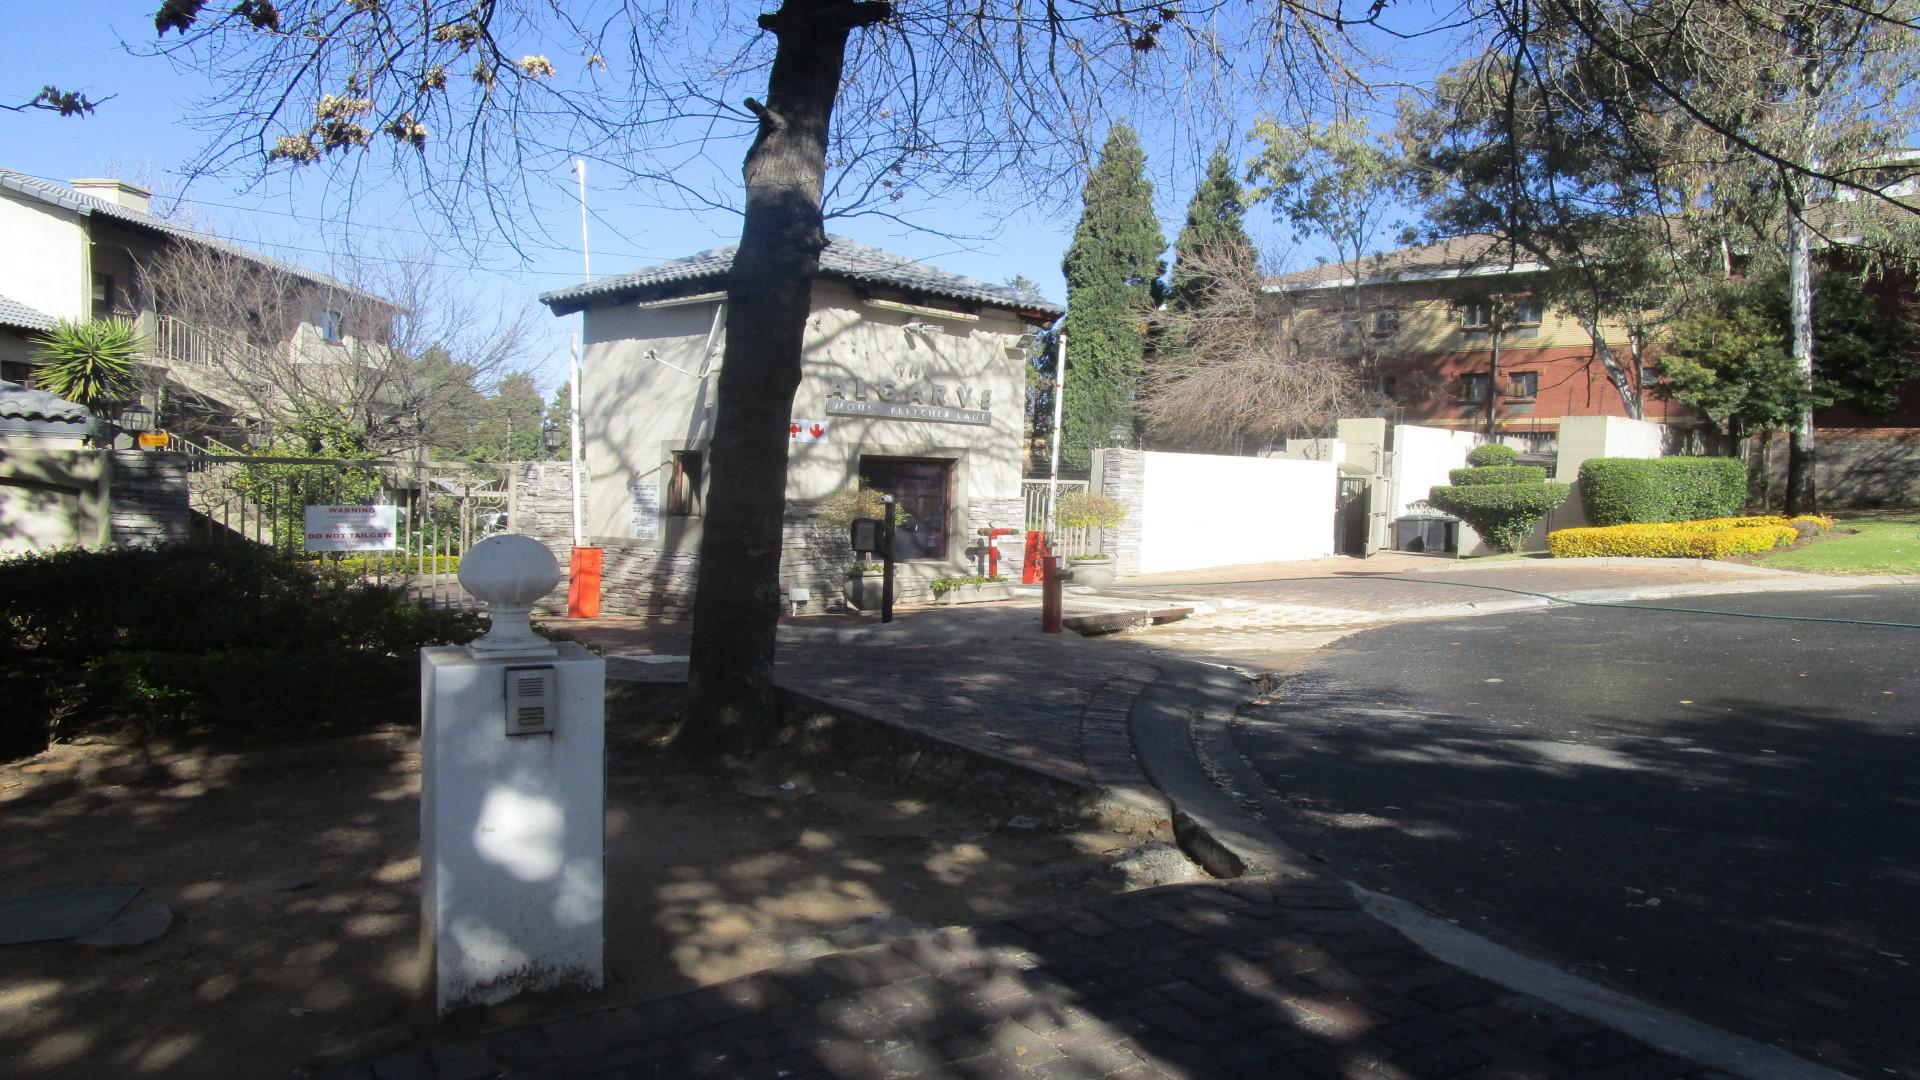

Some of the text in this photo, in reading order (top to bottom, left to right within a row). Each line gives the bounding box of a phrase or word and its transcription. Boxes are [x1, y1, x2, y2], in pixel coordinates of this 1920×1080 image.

[826, 376, 992, 411] ALGARVE
[890, 405, 950, 419] FLETCHER
[957, 412, 986, 423] LANE
[326, 532, 346, 540] NOT
[350, 531, 393, 540] TAILGATE
